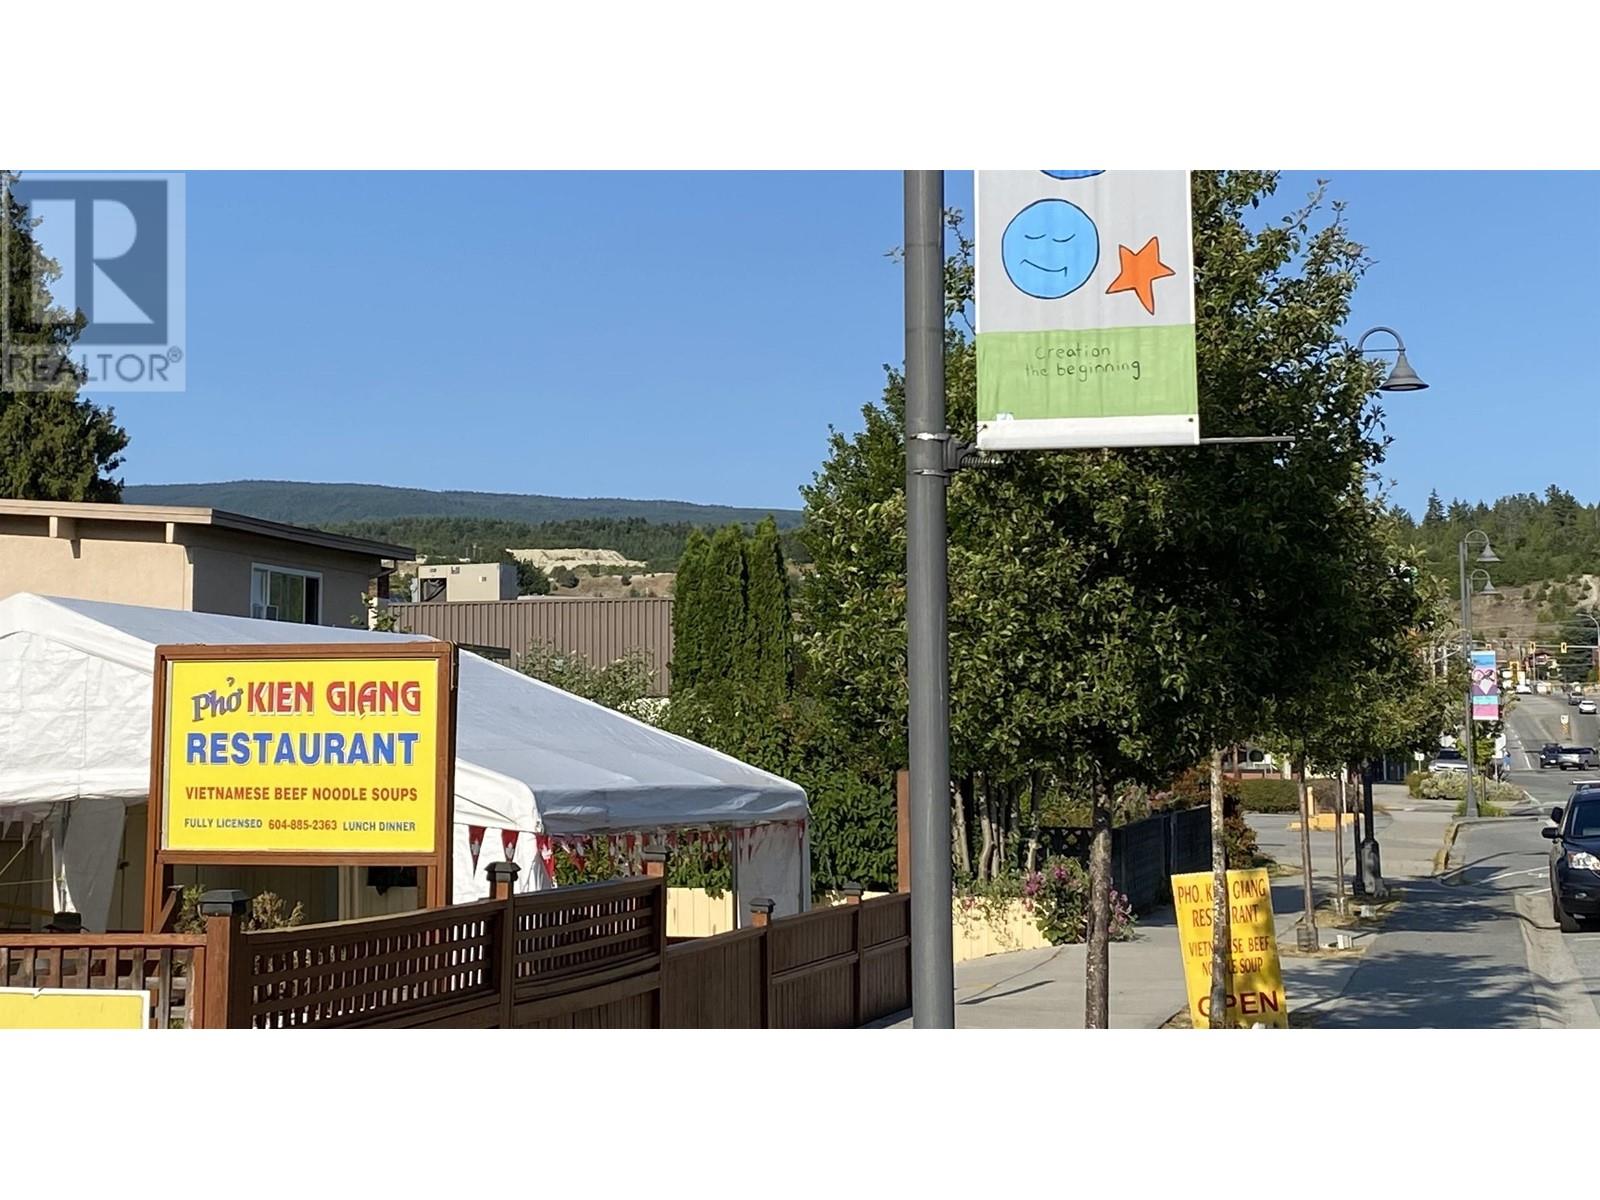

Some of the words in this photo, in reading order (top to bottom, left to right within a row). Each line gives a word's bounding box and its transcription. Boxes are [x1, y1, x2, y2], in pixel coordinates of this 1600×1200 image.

[1025, 363, 1049, 377] the
[1056, 360, 1141, 382] beginning
[247, 681, 315, 715] KIEN
[326, 680, 421, 716] GIANG
[186, 732, 419, 765] RESTAURANT
[185, 786, 270, 800] VIETNAMESE
[274, 787, 309, 801] BEEF
[312, 787, 367, 801] NOODLE
[371, 787, 418, 802] SOUPS
[184, 818, 214, 829] FULLY
[216, 818, 263, 829] LICENSED
[268, 819, 338, 831] 604-885-2363
[343, 821, 376, 832] LUNCH
[379, 821, 416, 832] DINNER
[1232, 878, 1267, 900] GIANG
[1248, 936, 1270, 952] BEEF
[1239, 957, 1264, 975] SOUP
